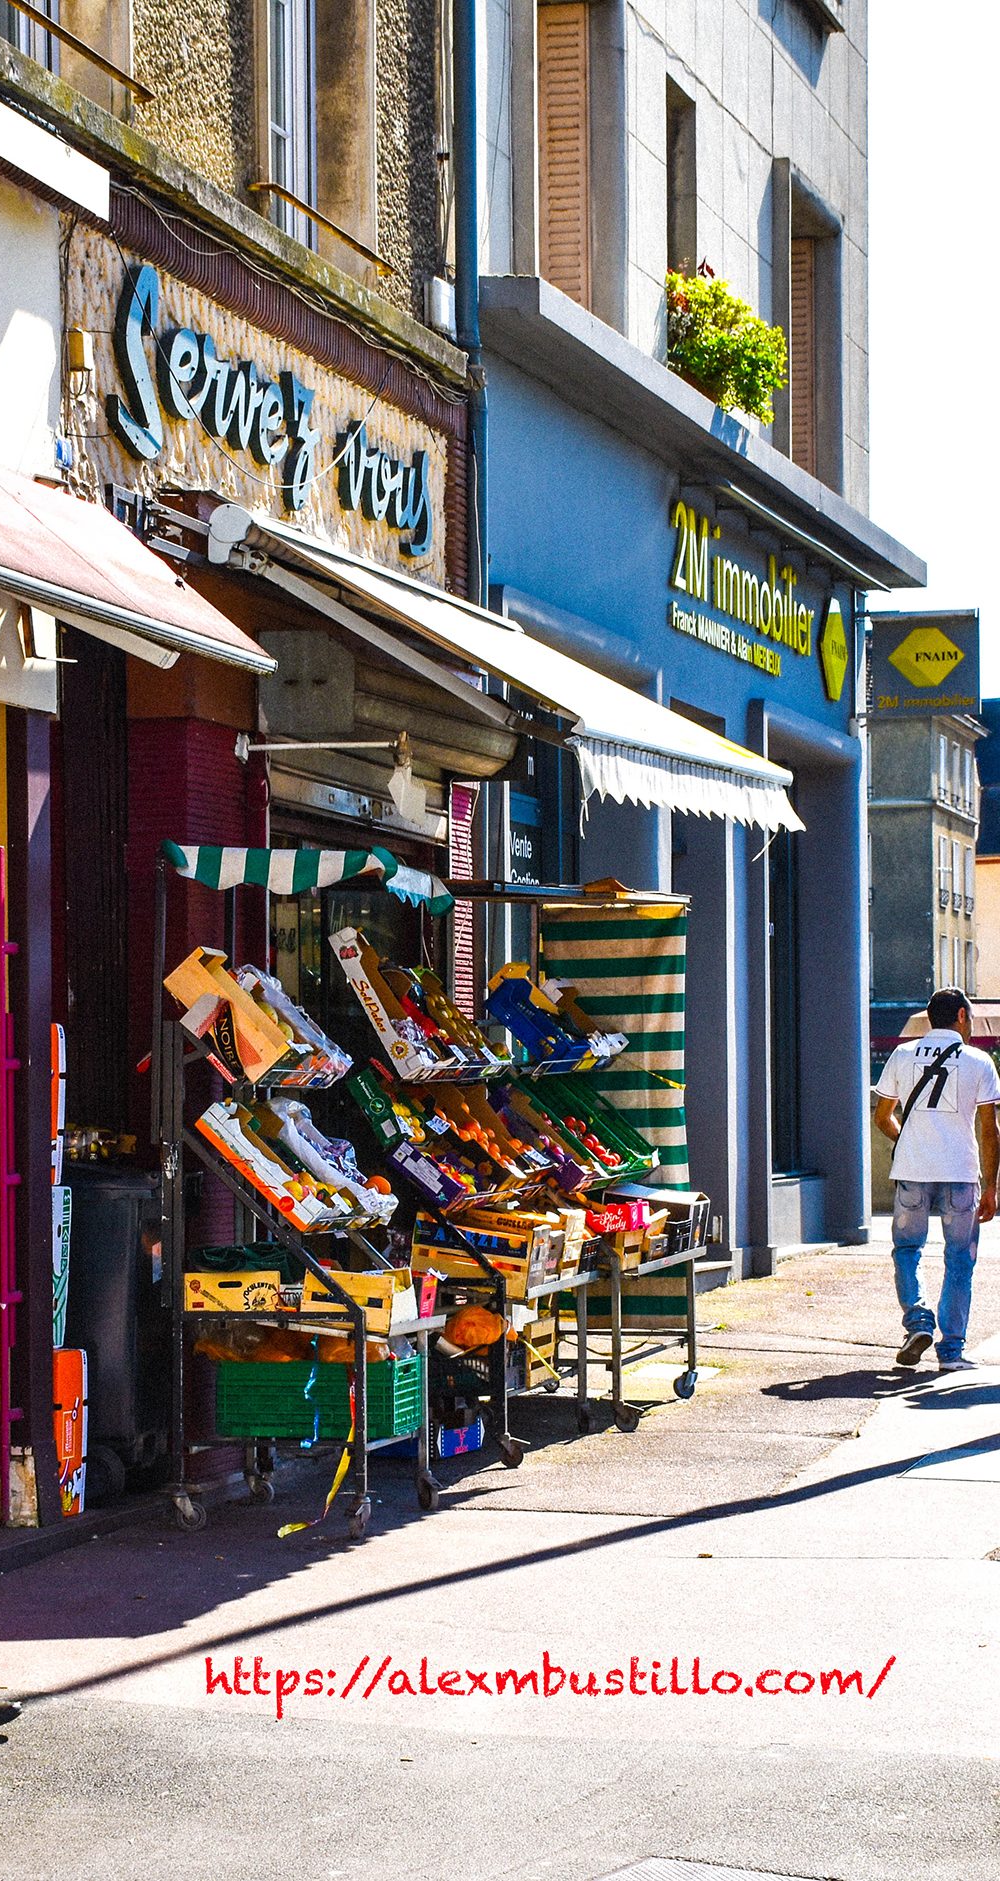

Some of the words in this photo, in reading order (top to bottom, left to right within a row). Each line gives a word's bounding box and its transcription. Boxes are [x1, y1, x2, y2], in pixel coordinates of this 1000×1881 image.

[671, 501, 709, 601] 2M
[713, 525, 815, 657] immobilier
[672, 600, 697, 636] Franck
[731, 631, 737, 656] &
[915, 651, 958, 662] FNAIM
[877, 696, 899, 709] 2M
[904, 694, 975, 708] immobilier
[509, 831, 533, 859] Vente
